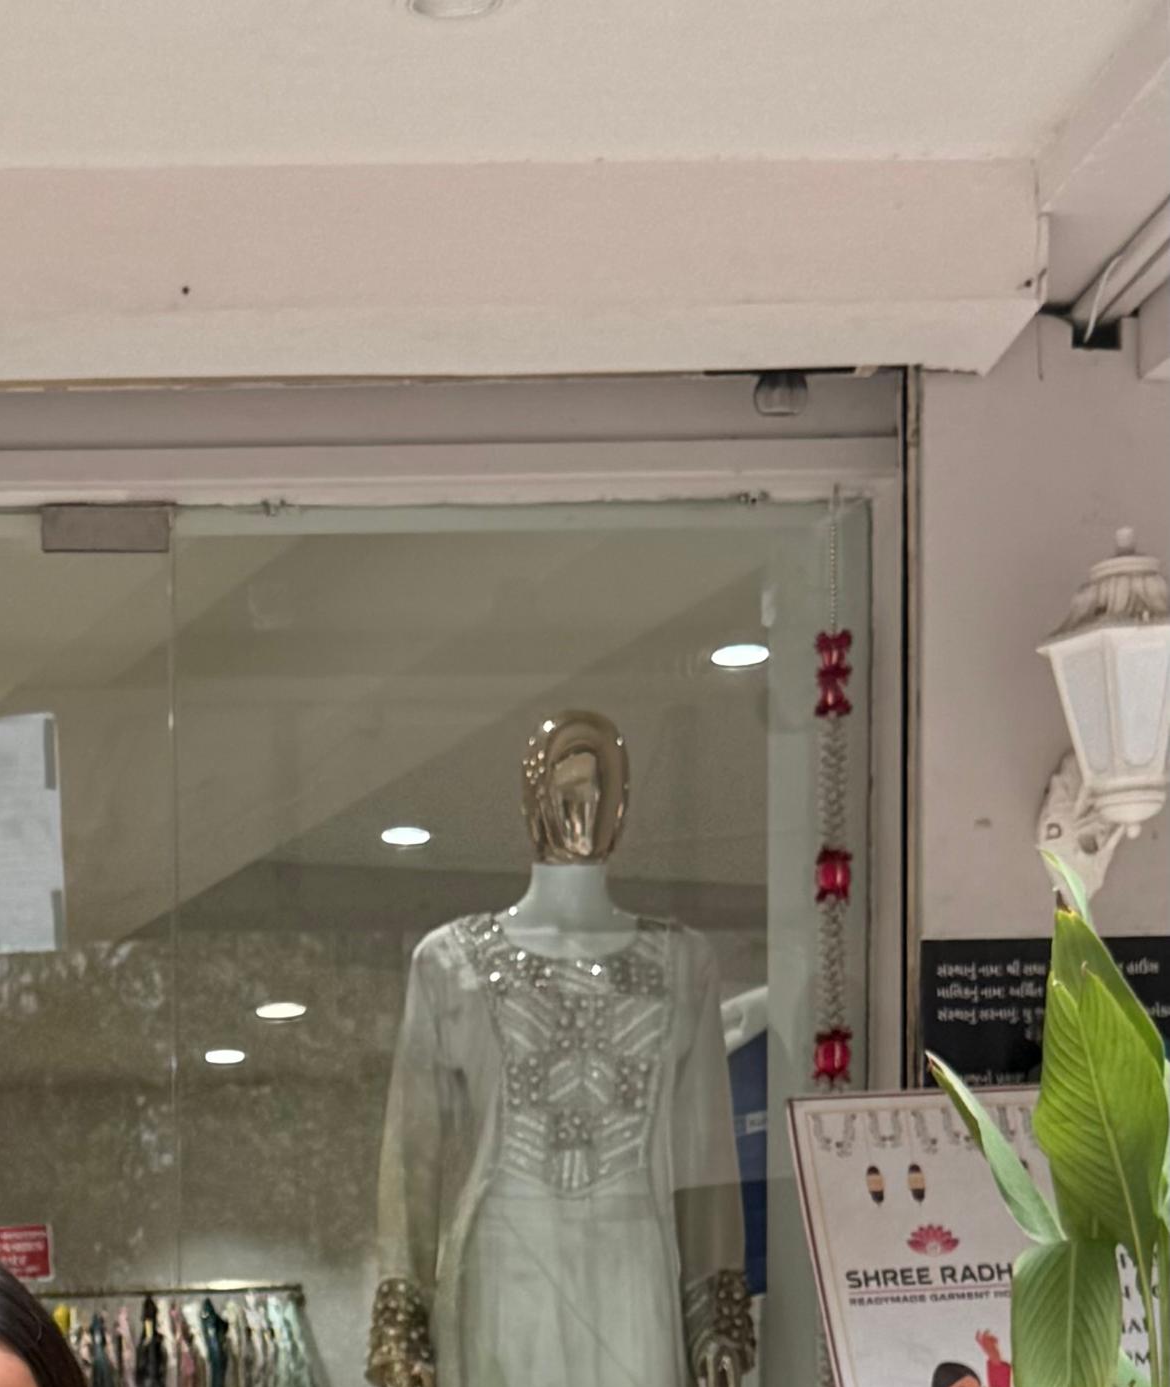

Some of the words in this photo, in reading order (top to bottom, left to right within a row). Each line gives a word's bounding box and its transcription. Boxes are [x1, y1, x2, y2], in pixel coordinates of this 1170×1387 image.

[846, 1266, 933, 1289] SHREE
[939, 1262, 1013, 1284] RADH
[849, 1294, 927, 1307] READYMADE
[928, 1289, 991, 1302] GARMENT
